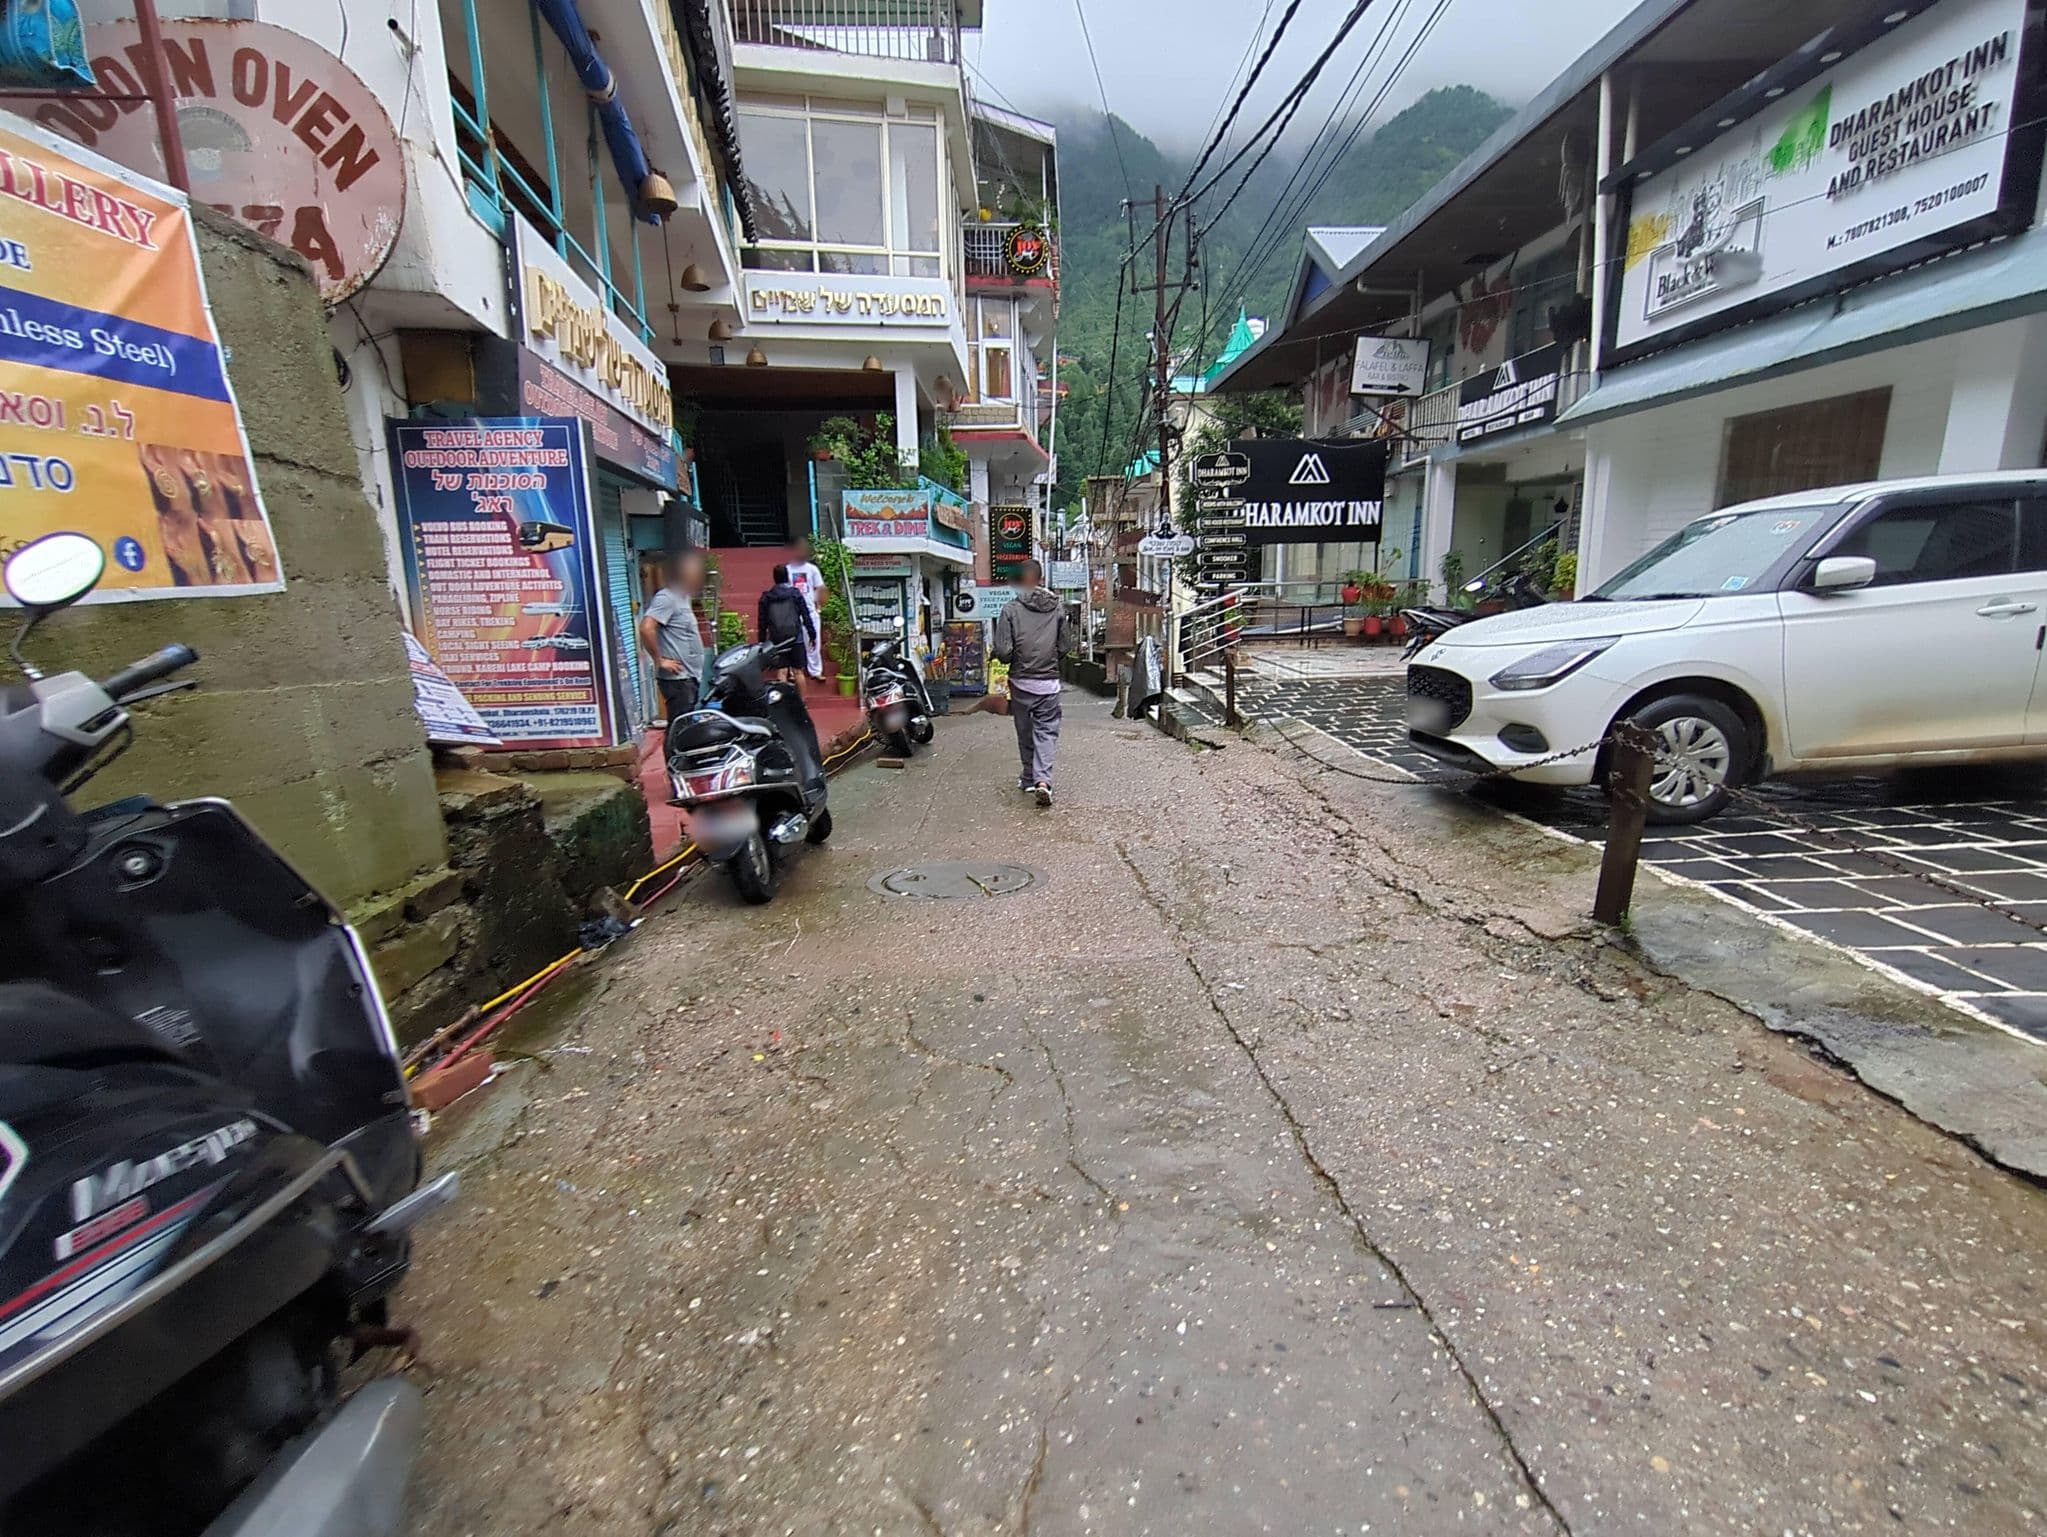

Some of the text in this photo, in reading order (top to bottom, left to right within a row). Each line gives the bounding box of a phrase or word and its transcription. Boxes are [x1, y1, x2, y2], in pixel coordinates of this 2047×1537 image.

[1830, 31, 2008, 148] DHARAMKOT INN
[232, 47, 380, 192] OVEN
[1848, 83, 1973, 162] GUEST HOUSE
[1827, 102, 1994, 199] AND RESTAURANT
[819, 285, 852, 314] של
[856, 292, 947, 316] המסעדה
[89, 328, 177, 377] Steel)
[424, 430, 543, 448] TRAVEL AGENCY
[406, 449, 568, 467] OUTDOOR ADVENTURE
[431, 470, 546, 490] הסוכנות של
[1235, 500, 1382, 528] HARAMKOT INN
[848, 521, 928, 536] TREK & DINE
